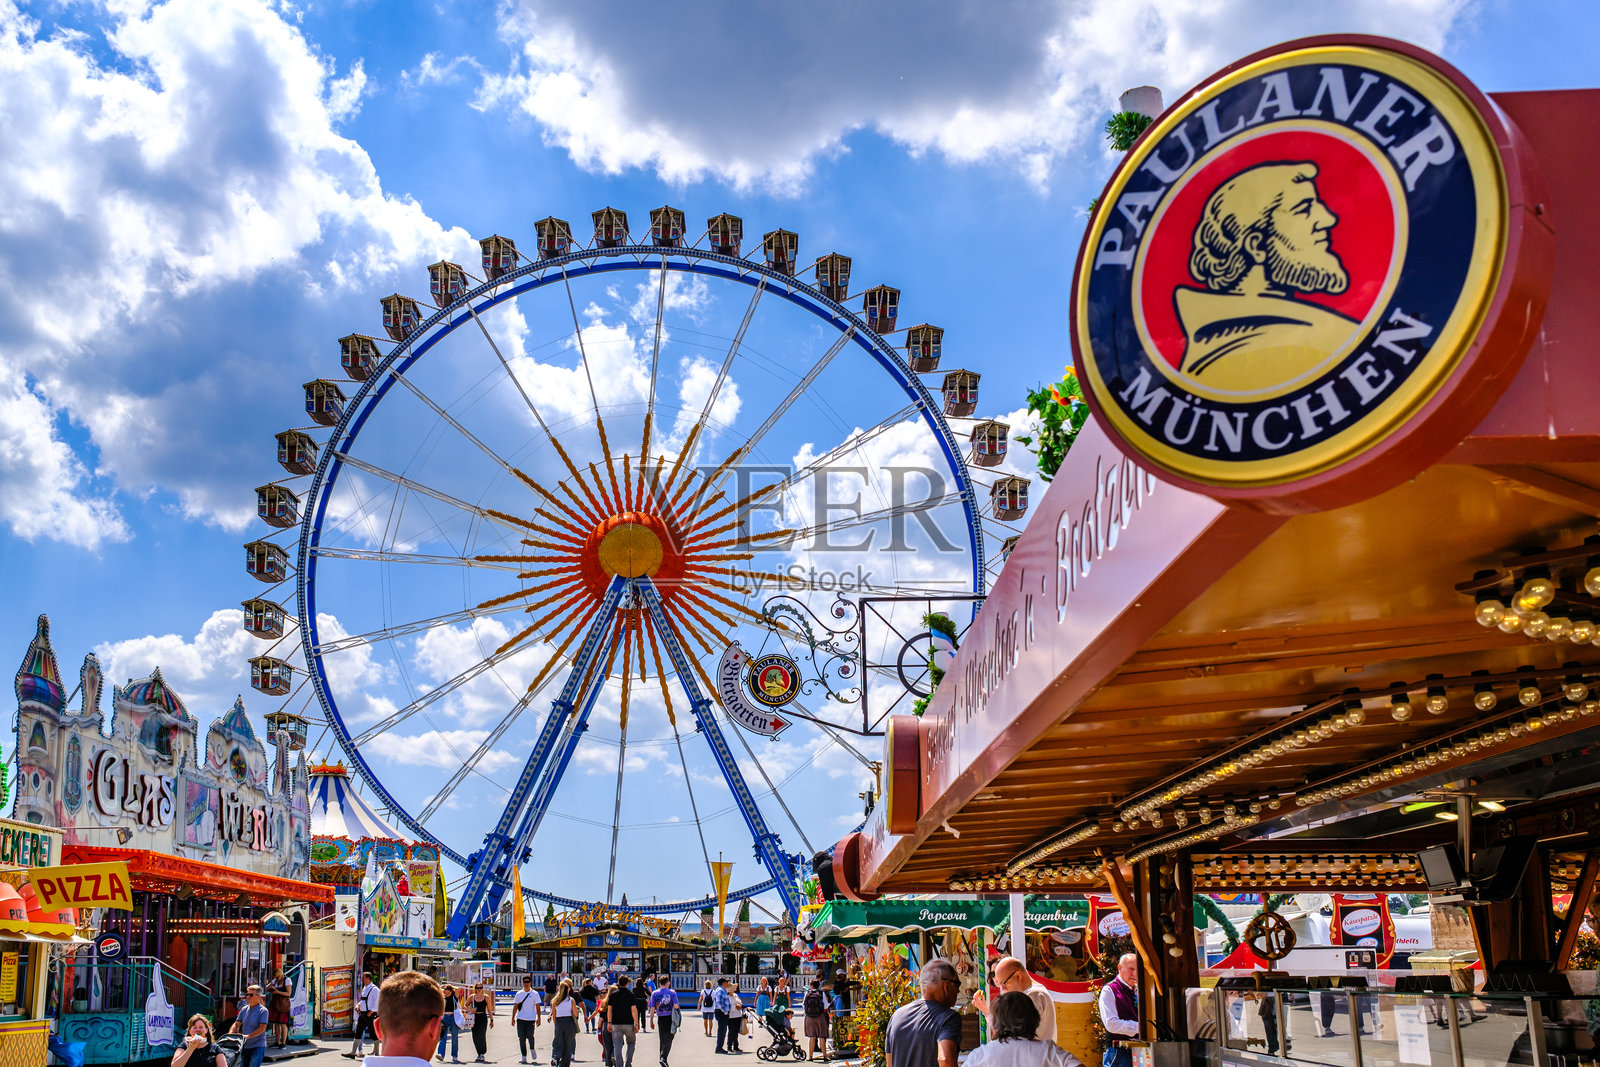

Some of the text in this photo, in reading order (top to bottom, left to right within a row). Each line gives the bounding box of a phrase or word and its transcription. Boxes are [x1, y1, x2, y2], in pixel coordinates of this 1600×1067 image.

[1095, 67, 1456, 271] PAULANER
[1119, 308, 1434, 453] MÜNCHEN
[753, 658, 795, 677] PAULANER
[722, 659, 768, 730] Biergarten
[95, 750, 174, 827] GLAS
[0, 827, 51, 866] CKEREI
[37, 873, 128, 905] PIZZA
[549, 904, 672, 934] Willenborg
[918, 909, 967, 924] Popcorn
[561, 938, 580, 946] KASSE
